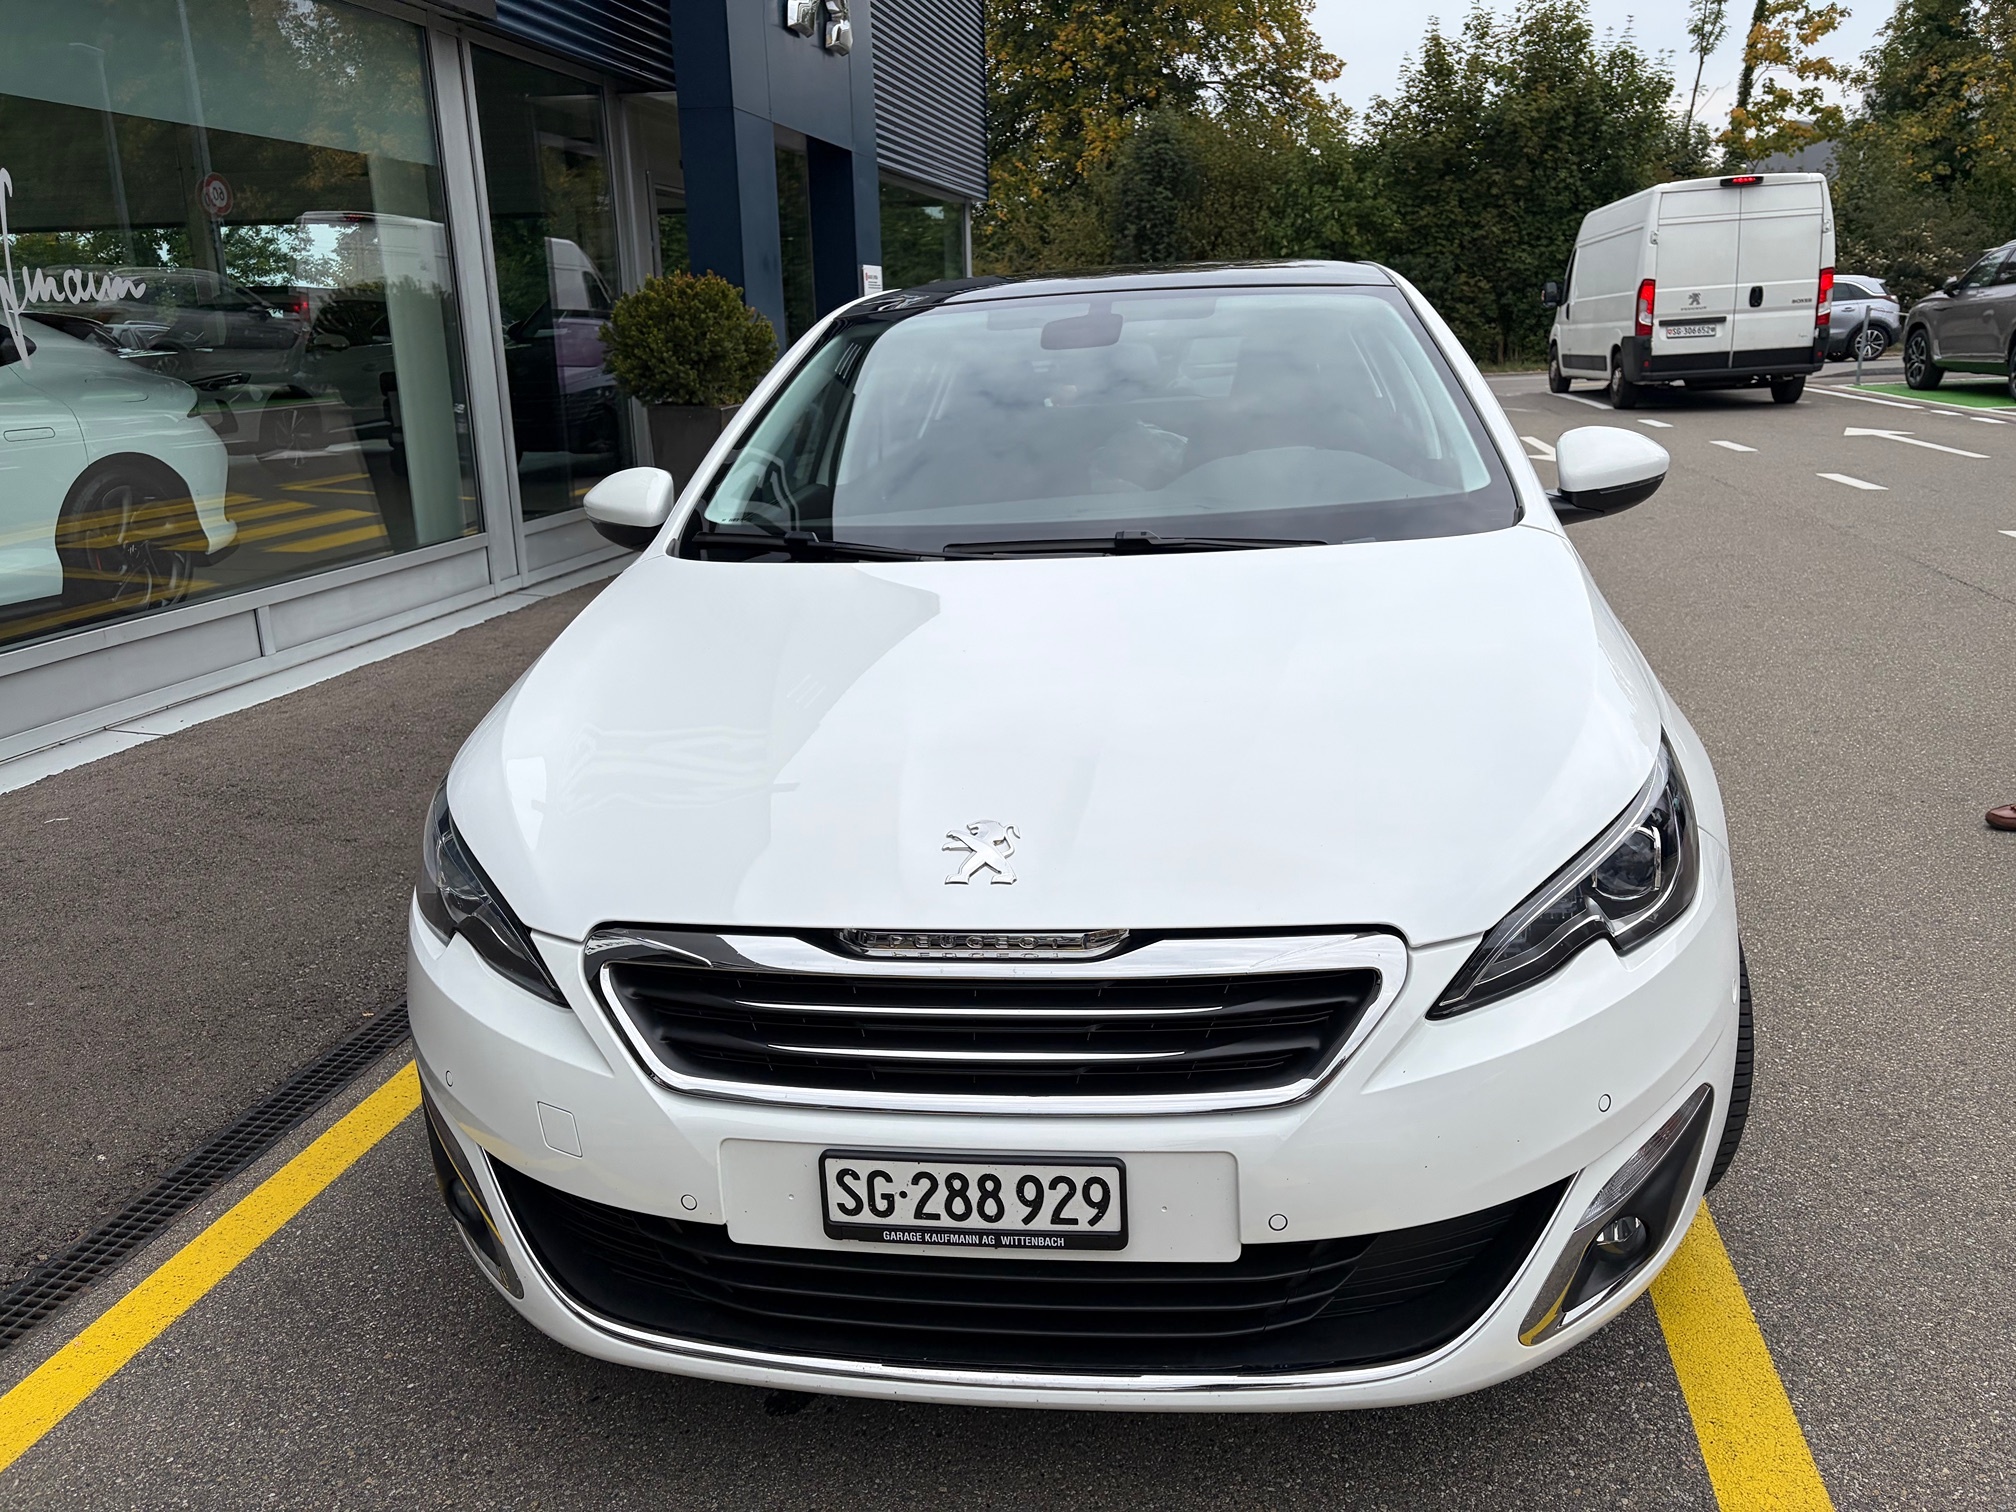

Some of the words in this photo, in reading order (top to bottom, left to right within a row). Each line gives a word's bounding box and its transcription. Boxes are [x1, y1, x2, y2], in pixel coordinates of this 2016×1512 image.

[888, 934, 1061, 950] PEUGEOT
[883, 1230, 922, 1242] GARAGE
[924, 1232, 979, 1244] KAUFMANN
[982, 1235, 995, 1245] AG
[1001, 1236, 1065, 1247] WITTENBACH
